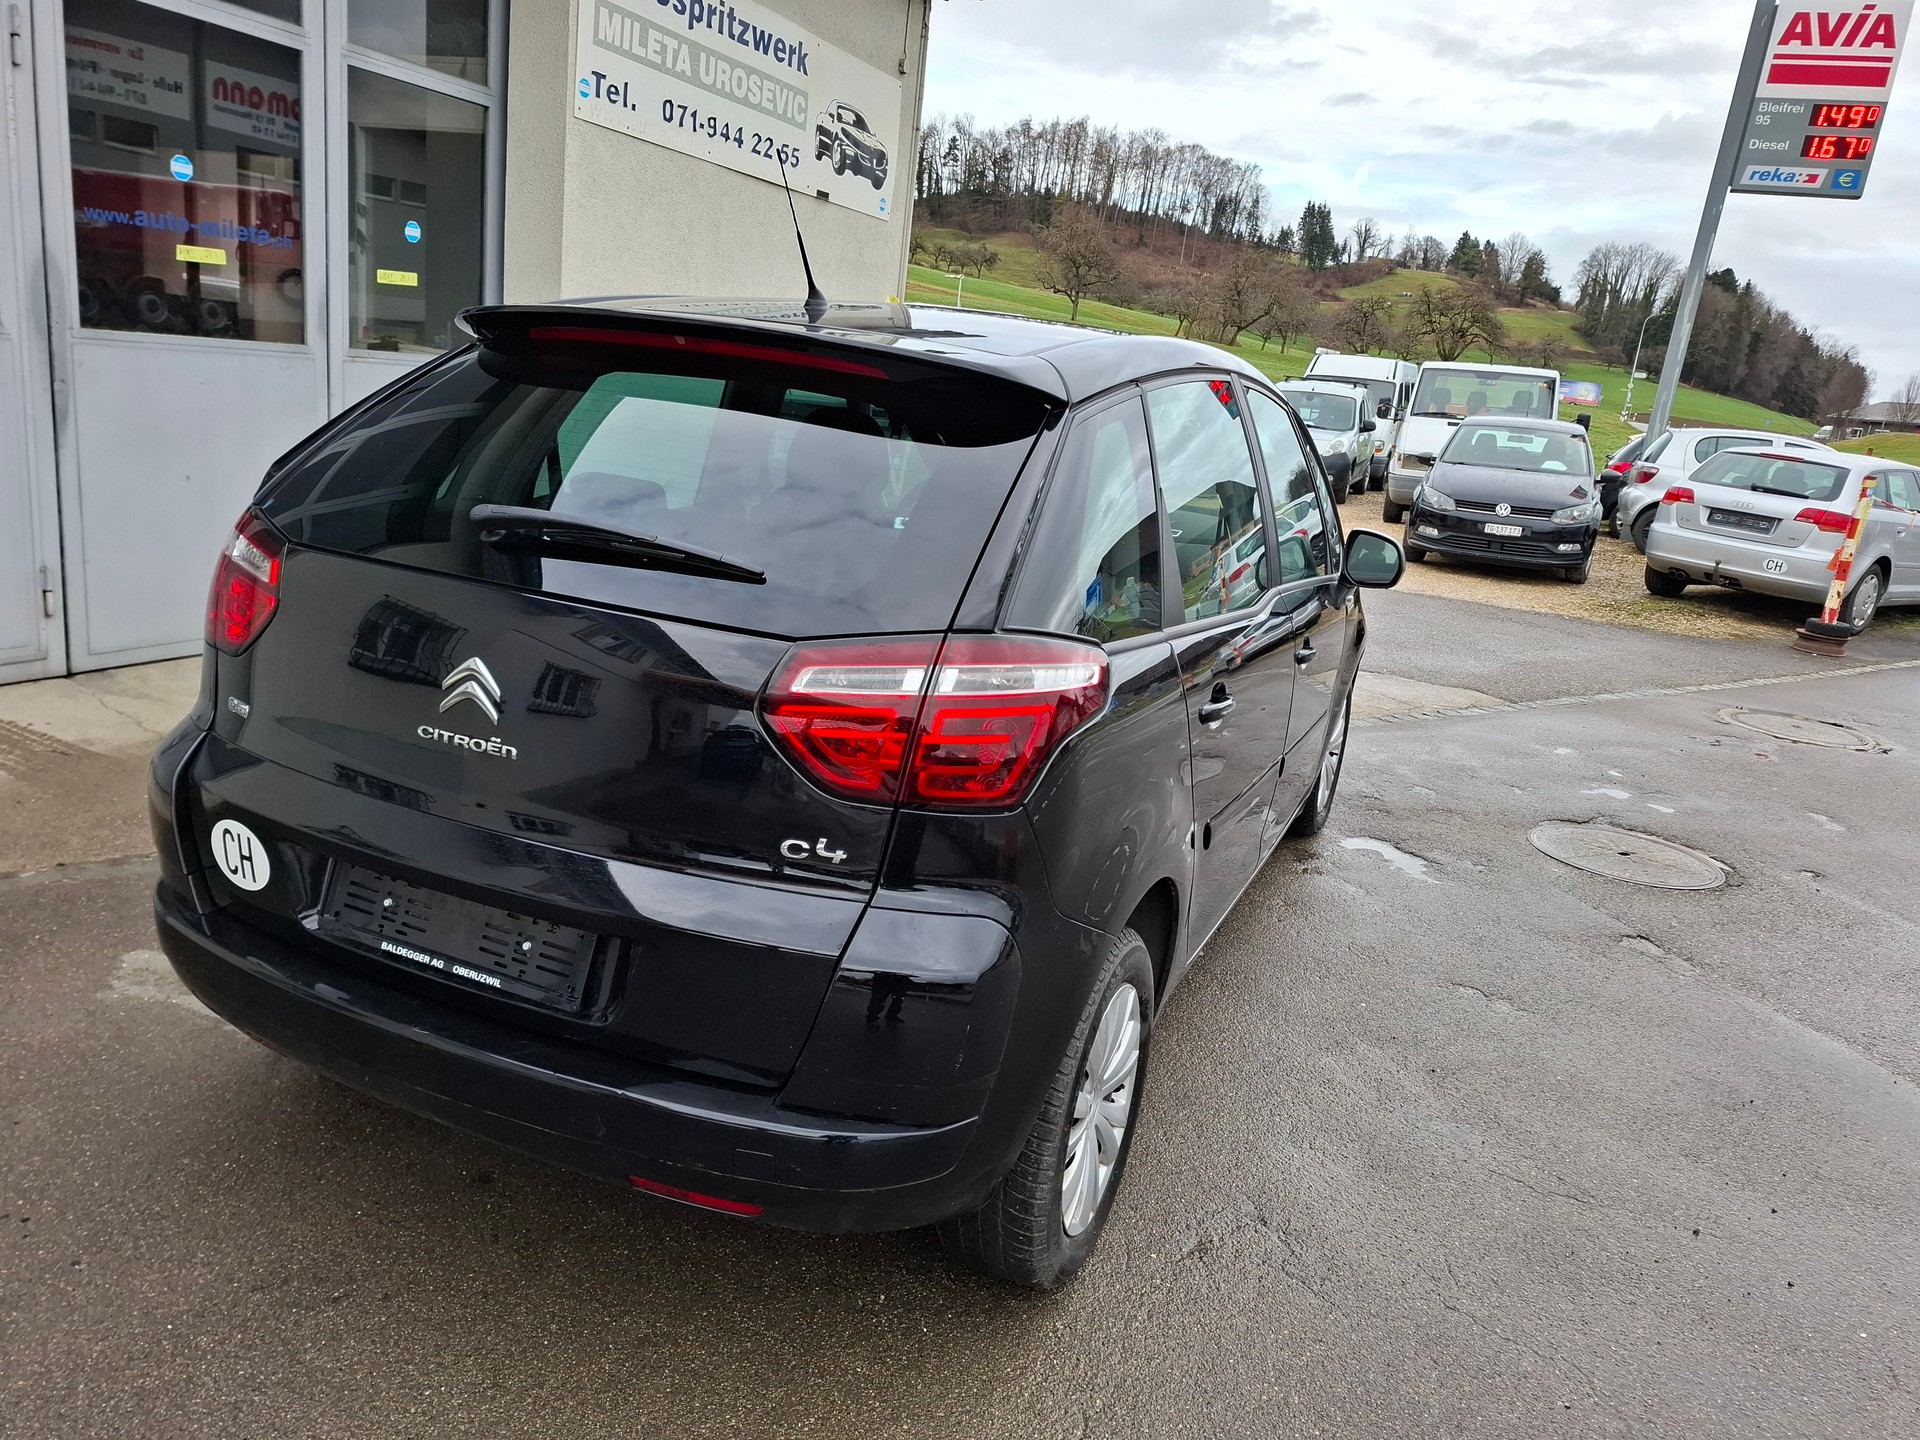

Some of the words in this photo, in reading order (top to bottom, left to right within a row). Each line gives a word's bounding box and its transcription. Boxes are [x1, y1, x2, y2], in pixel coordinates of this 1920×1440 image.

[598, 6, 692, 77] MILETA
[700, 52, 806, 123] UROSEVIC
[591, 70, 637, 112] Tel.
[662, 99, 744, 149] 071-944
[751, 132, 774, 160] 22
[780, 143, 800, 168] 55
[1754, 115, 1771, 126] 95
[1758, 102, 1805, 114] Bleifrei
[1749, 139, 1790, 151] Diesel
[1765, 559, 1784, 572] CH
[222, 827, 257, 884] CH
[780, 837, 848, 864] C4
[381, 941, 431, 965] BALDEGGER
[430, 958, 445, 969] AG
[452, 965, 501, 988] OBERUZWIL
